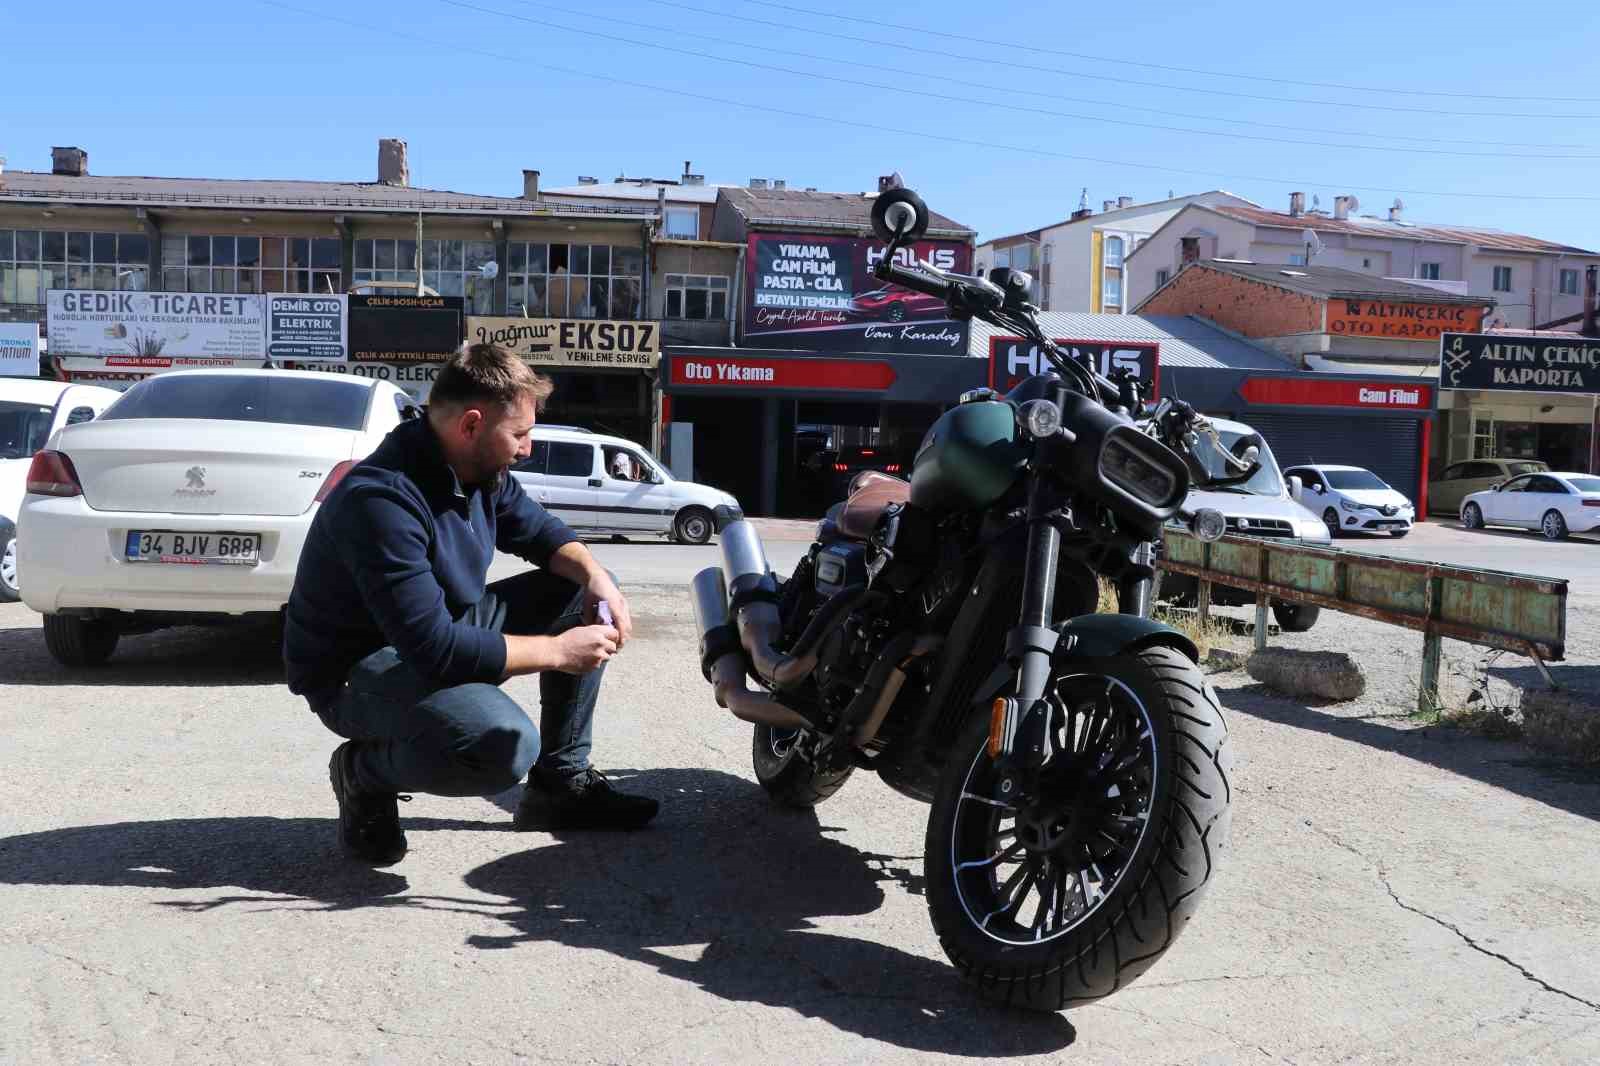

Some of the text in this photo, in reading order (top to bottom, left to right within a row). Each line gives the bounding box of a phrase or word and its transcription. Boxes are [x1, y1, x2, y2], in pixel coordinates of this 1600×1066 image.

[779, 244, 829, 259] YIKAMA
[772, 260, 801, 273] CAM
[763, 276, 804, 289] PASTA
[313, 301, 340, 312] OTO
[756, 293, 800, 306] DETAYLI
[864, 325, 893, 339] Can
[1331, 319, 1374, 334] OTO
[560, 322, 654, 353] EKSOZ
[1479, 343, 1536, 362] ALTIN
[353, 363, 390, 380] OTO
[396, 367, 441, 380] ELEK
[685, 363, 712, 379] Oto
[1493, 367, 1584, 387] KAPORTA
[1359, 387, 1387, 403] Cam
[140, 533, 254, 557] 34 BJV 688
